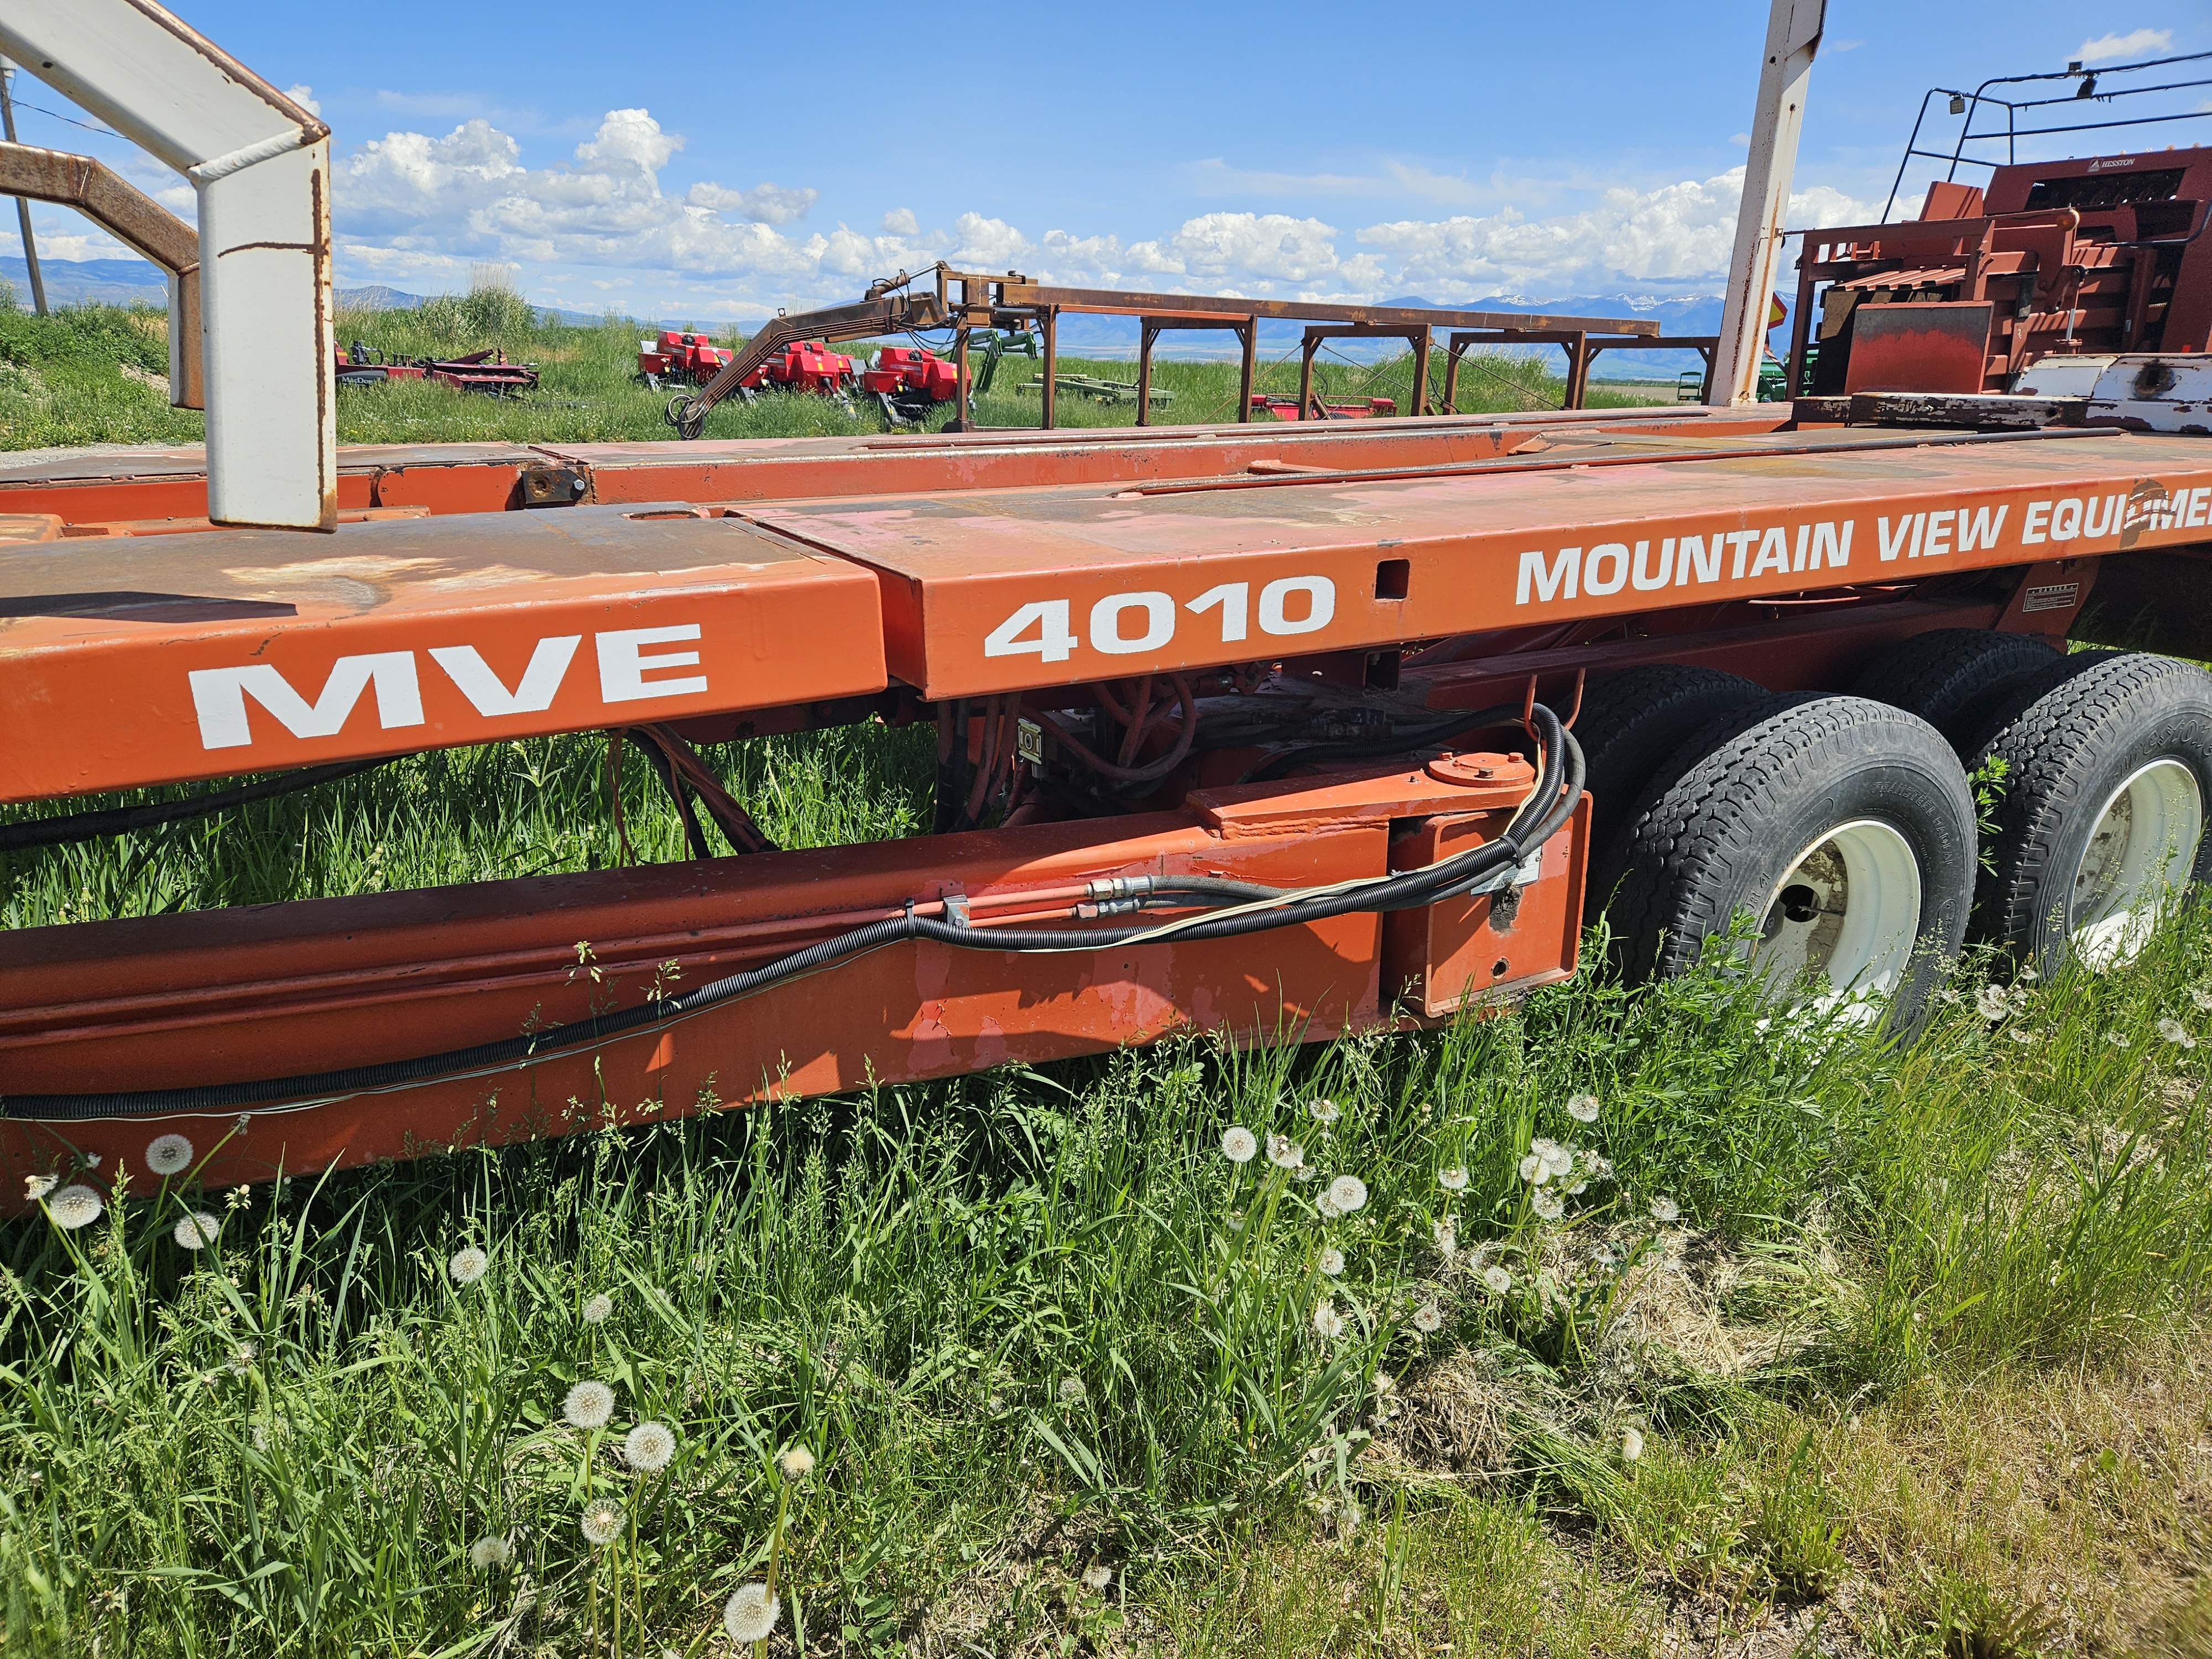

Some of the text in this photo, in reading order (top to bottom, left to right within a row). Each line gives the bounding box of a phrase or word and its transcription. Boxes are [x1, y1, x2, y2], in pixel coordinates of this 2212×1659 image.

[2101, 159, 2135, 167] HESSTON
[1516, 520, 1855, 605] MOUNTAIN
[1877, 504, 2009, 561] VIEW
[984, 575, 1336, 662] 4010
[188, 624, 708, 750] MVE
